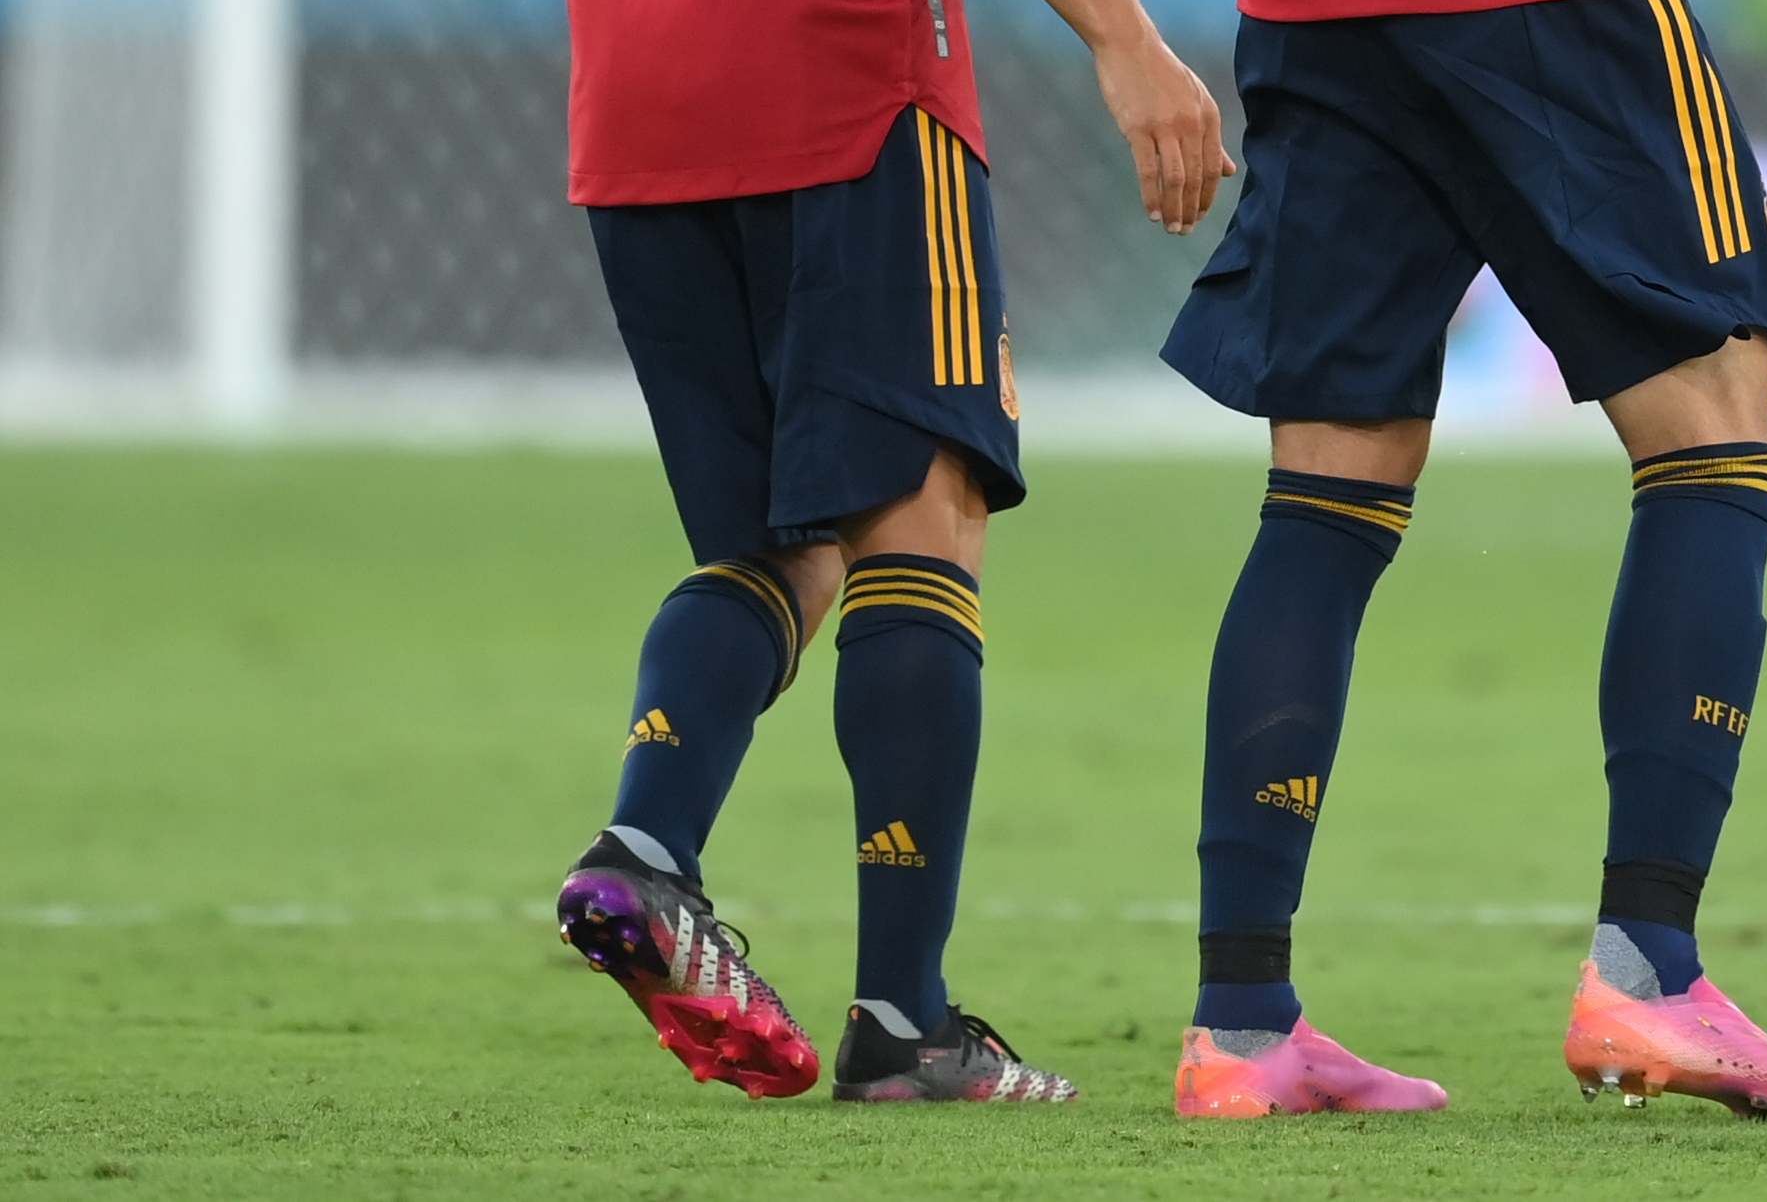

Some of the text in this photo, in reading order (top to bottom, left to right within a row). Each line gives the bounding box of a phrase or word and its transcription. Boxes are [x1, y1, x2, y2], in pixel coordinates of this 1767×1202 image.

[1692, 694, 1749, 737] RFEF
[1255, 790, 1316, 823] adidas
[856, 849, 926, 868] adidas
